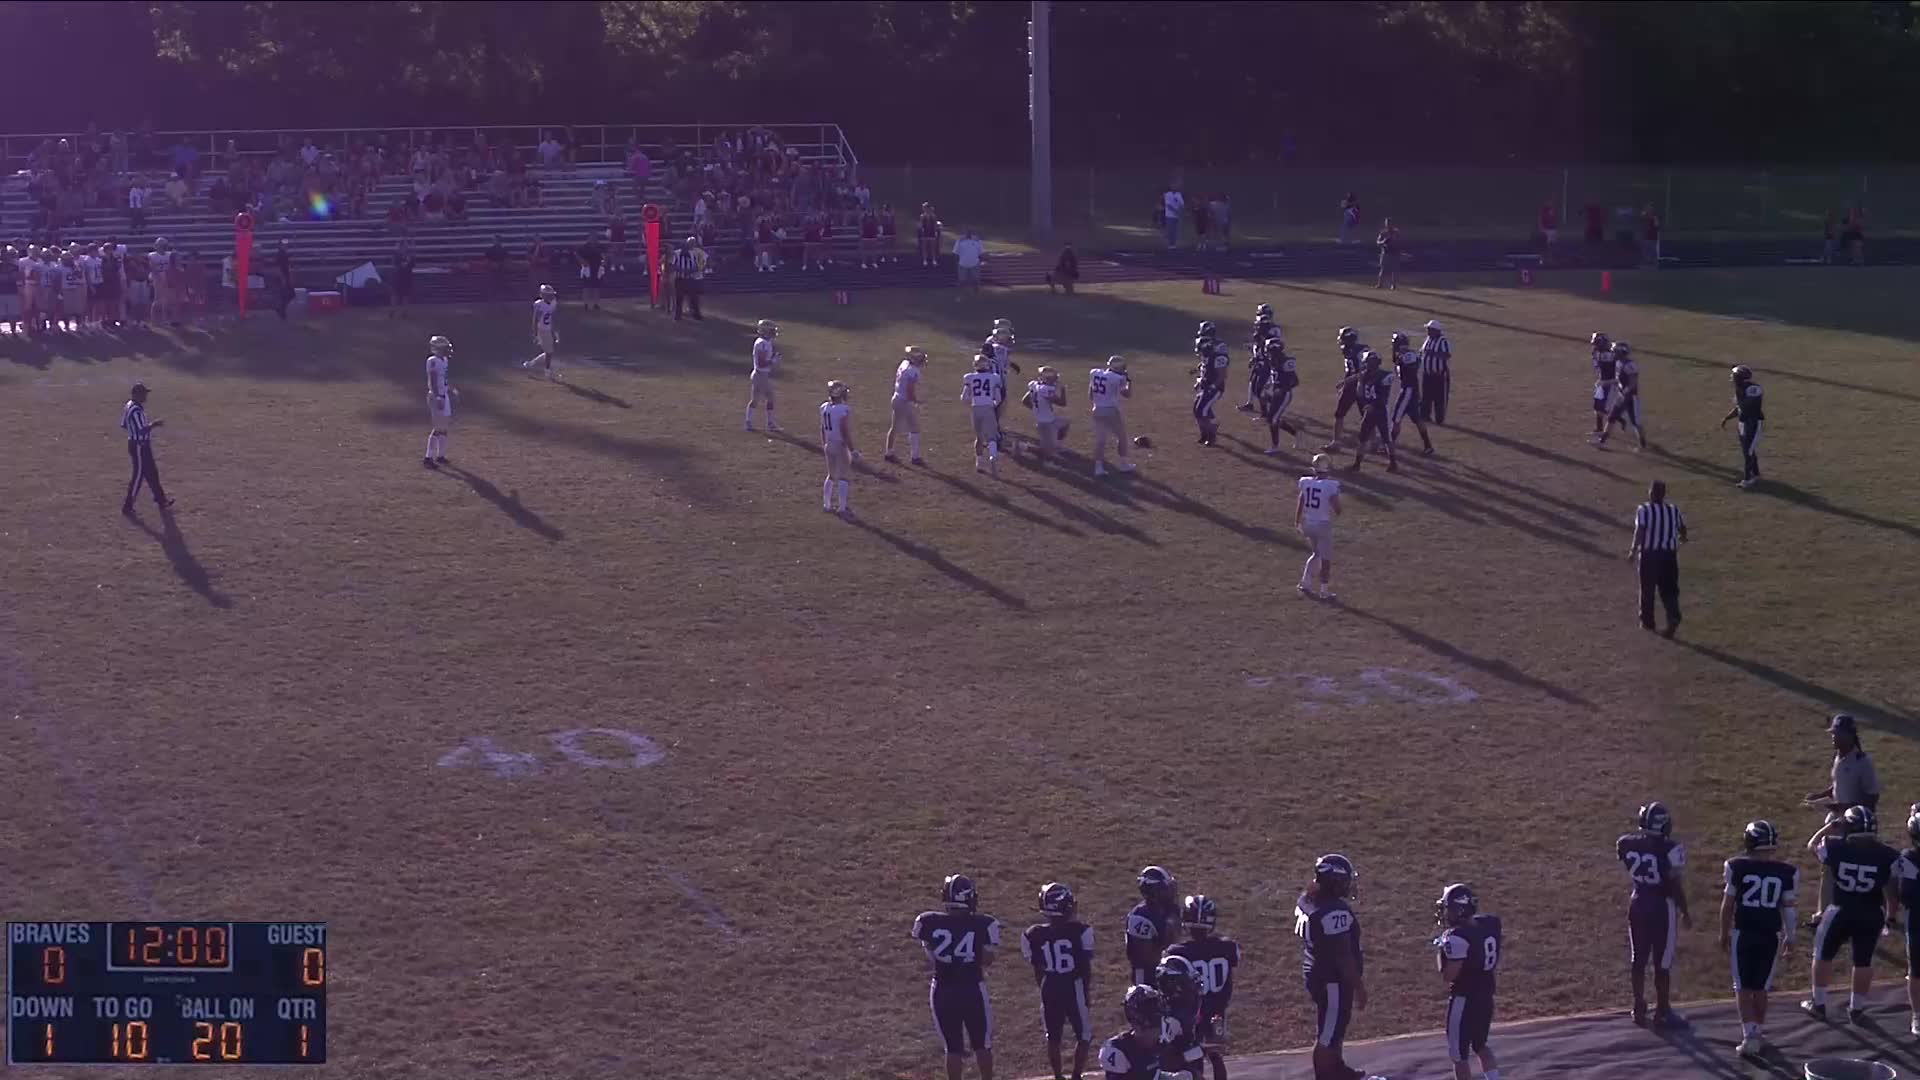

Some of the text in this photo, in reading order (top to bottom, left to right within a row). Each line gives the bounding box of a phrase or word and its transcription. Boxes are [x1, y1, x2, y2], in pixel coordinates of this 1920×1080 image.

[972, 378, 991, 397] 24
[823, 411, 833, 431] 11
[1304, 487, 1322, 509] 15
[1625, 851, 1661, 885] 23
[1836, 861, 1879, 893] 55
[1742, 874, 1783, 908] 20
[1133, 920, 1151, 936] 43
[1331, 914, 1348, 930] 70
[931, 928, 976, 963] 24
[1041, 938, 1075, 974] 16
[1483, 935, 1498, 972] 8
[1107, 1051, 1117, 1067] 4
